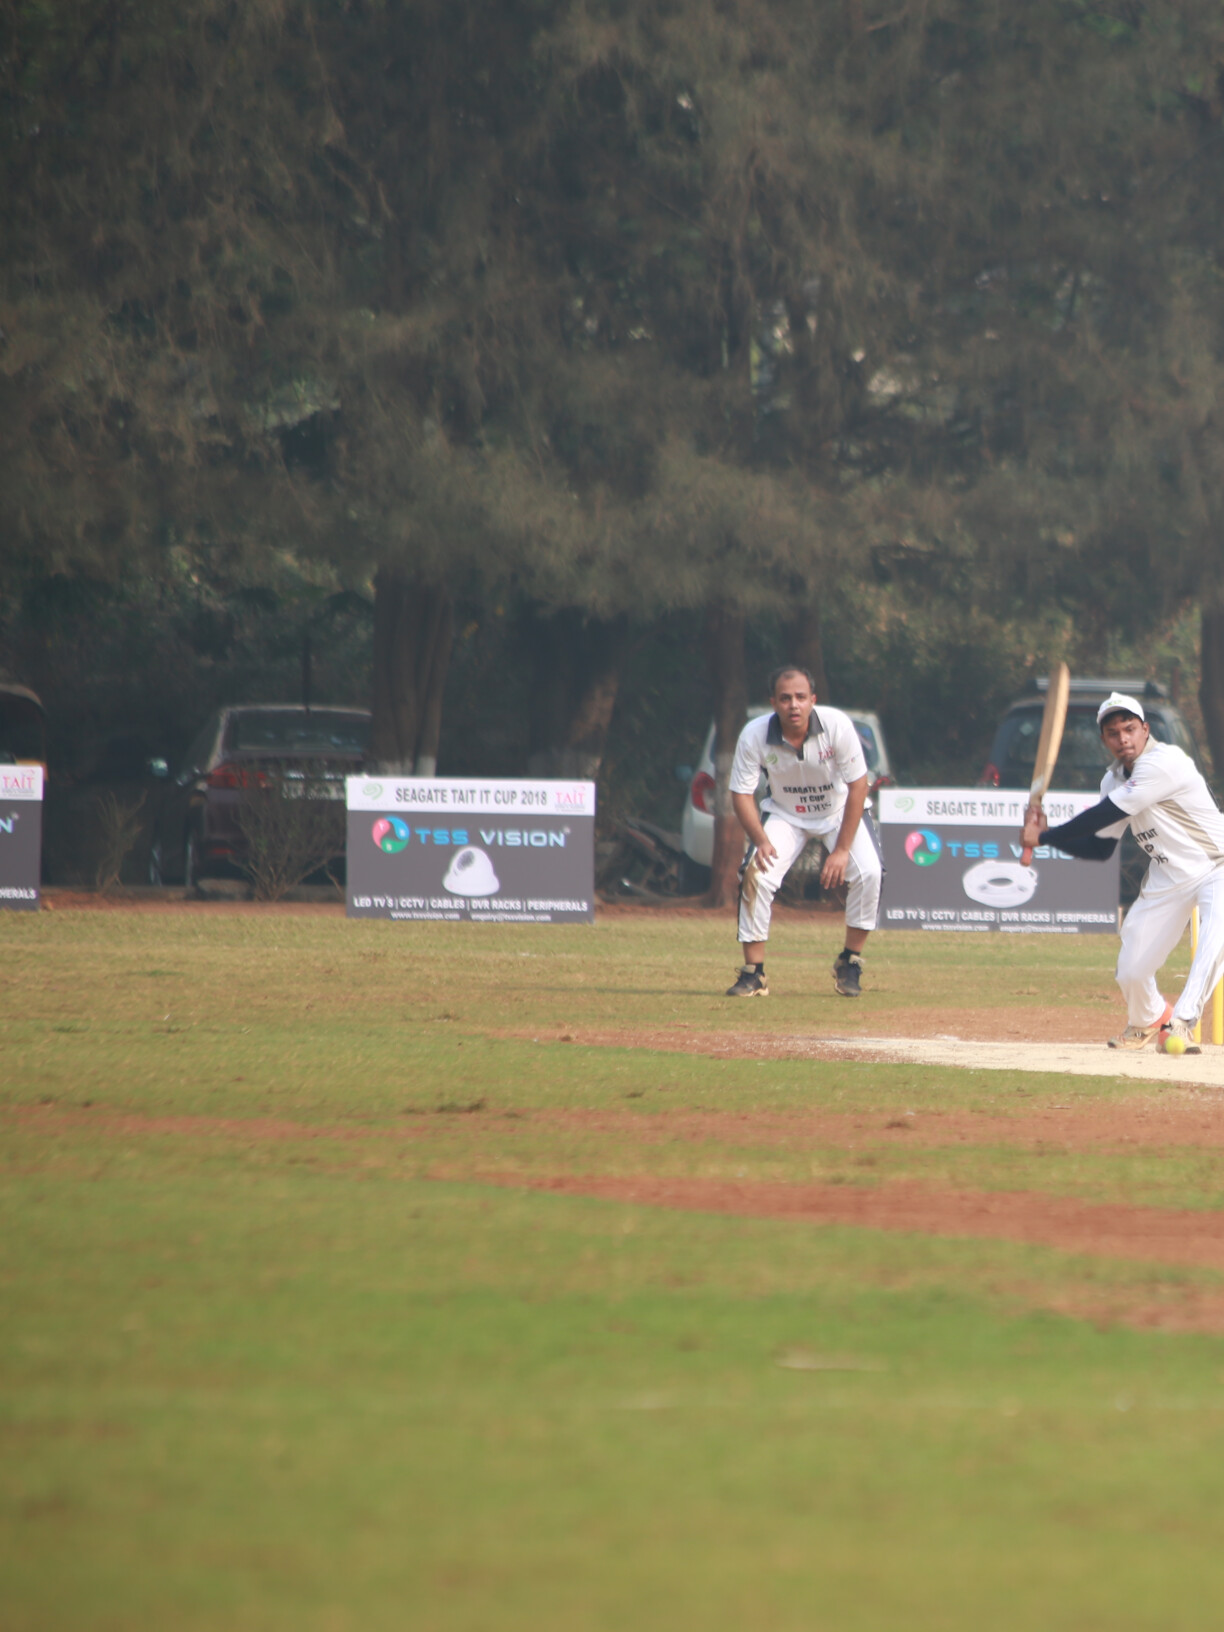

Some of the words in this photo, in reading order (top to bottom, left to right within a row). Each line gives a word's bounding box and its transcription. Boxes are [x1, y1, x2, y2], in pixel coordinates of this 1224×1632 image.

[3, 776, 34, 788] TAIT
[395, 787, 448, 804] SEAGATE
[451, 789, 476, 805] TAIT
[480, 789, 491, 805] IT
[494, 790, 517, 805] CUP
[521, 790, 548, 806] 2018
[555, 791, 585, 805] TAIT
[926, 800, 976, 815] SEAGATE
[979, 802, 1005, 816] TAIT
[1009, 802, 1019, 817] IT
[1050, 804, 1074, 818] 2018
[415, 828, 469, 846] TSS
[946, 843, 999, 858] TSS
[353, 896, 372, 907] LED
[400, 897, 424, 908] CCTV
[430, 898, 465, 909] CABLES
[491, 900, 521, 911] RACKS
[527, 900, 588, 912] PERIPHERALS
[886, 909, 905, 920] LED
[931, 910, 956, 921] CCTV
[961, 911, 995, 922] CABLES
[1021, 912, 1050, 923] RACKS
[1056, 913, 1116, 924] PERIPHERALS
